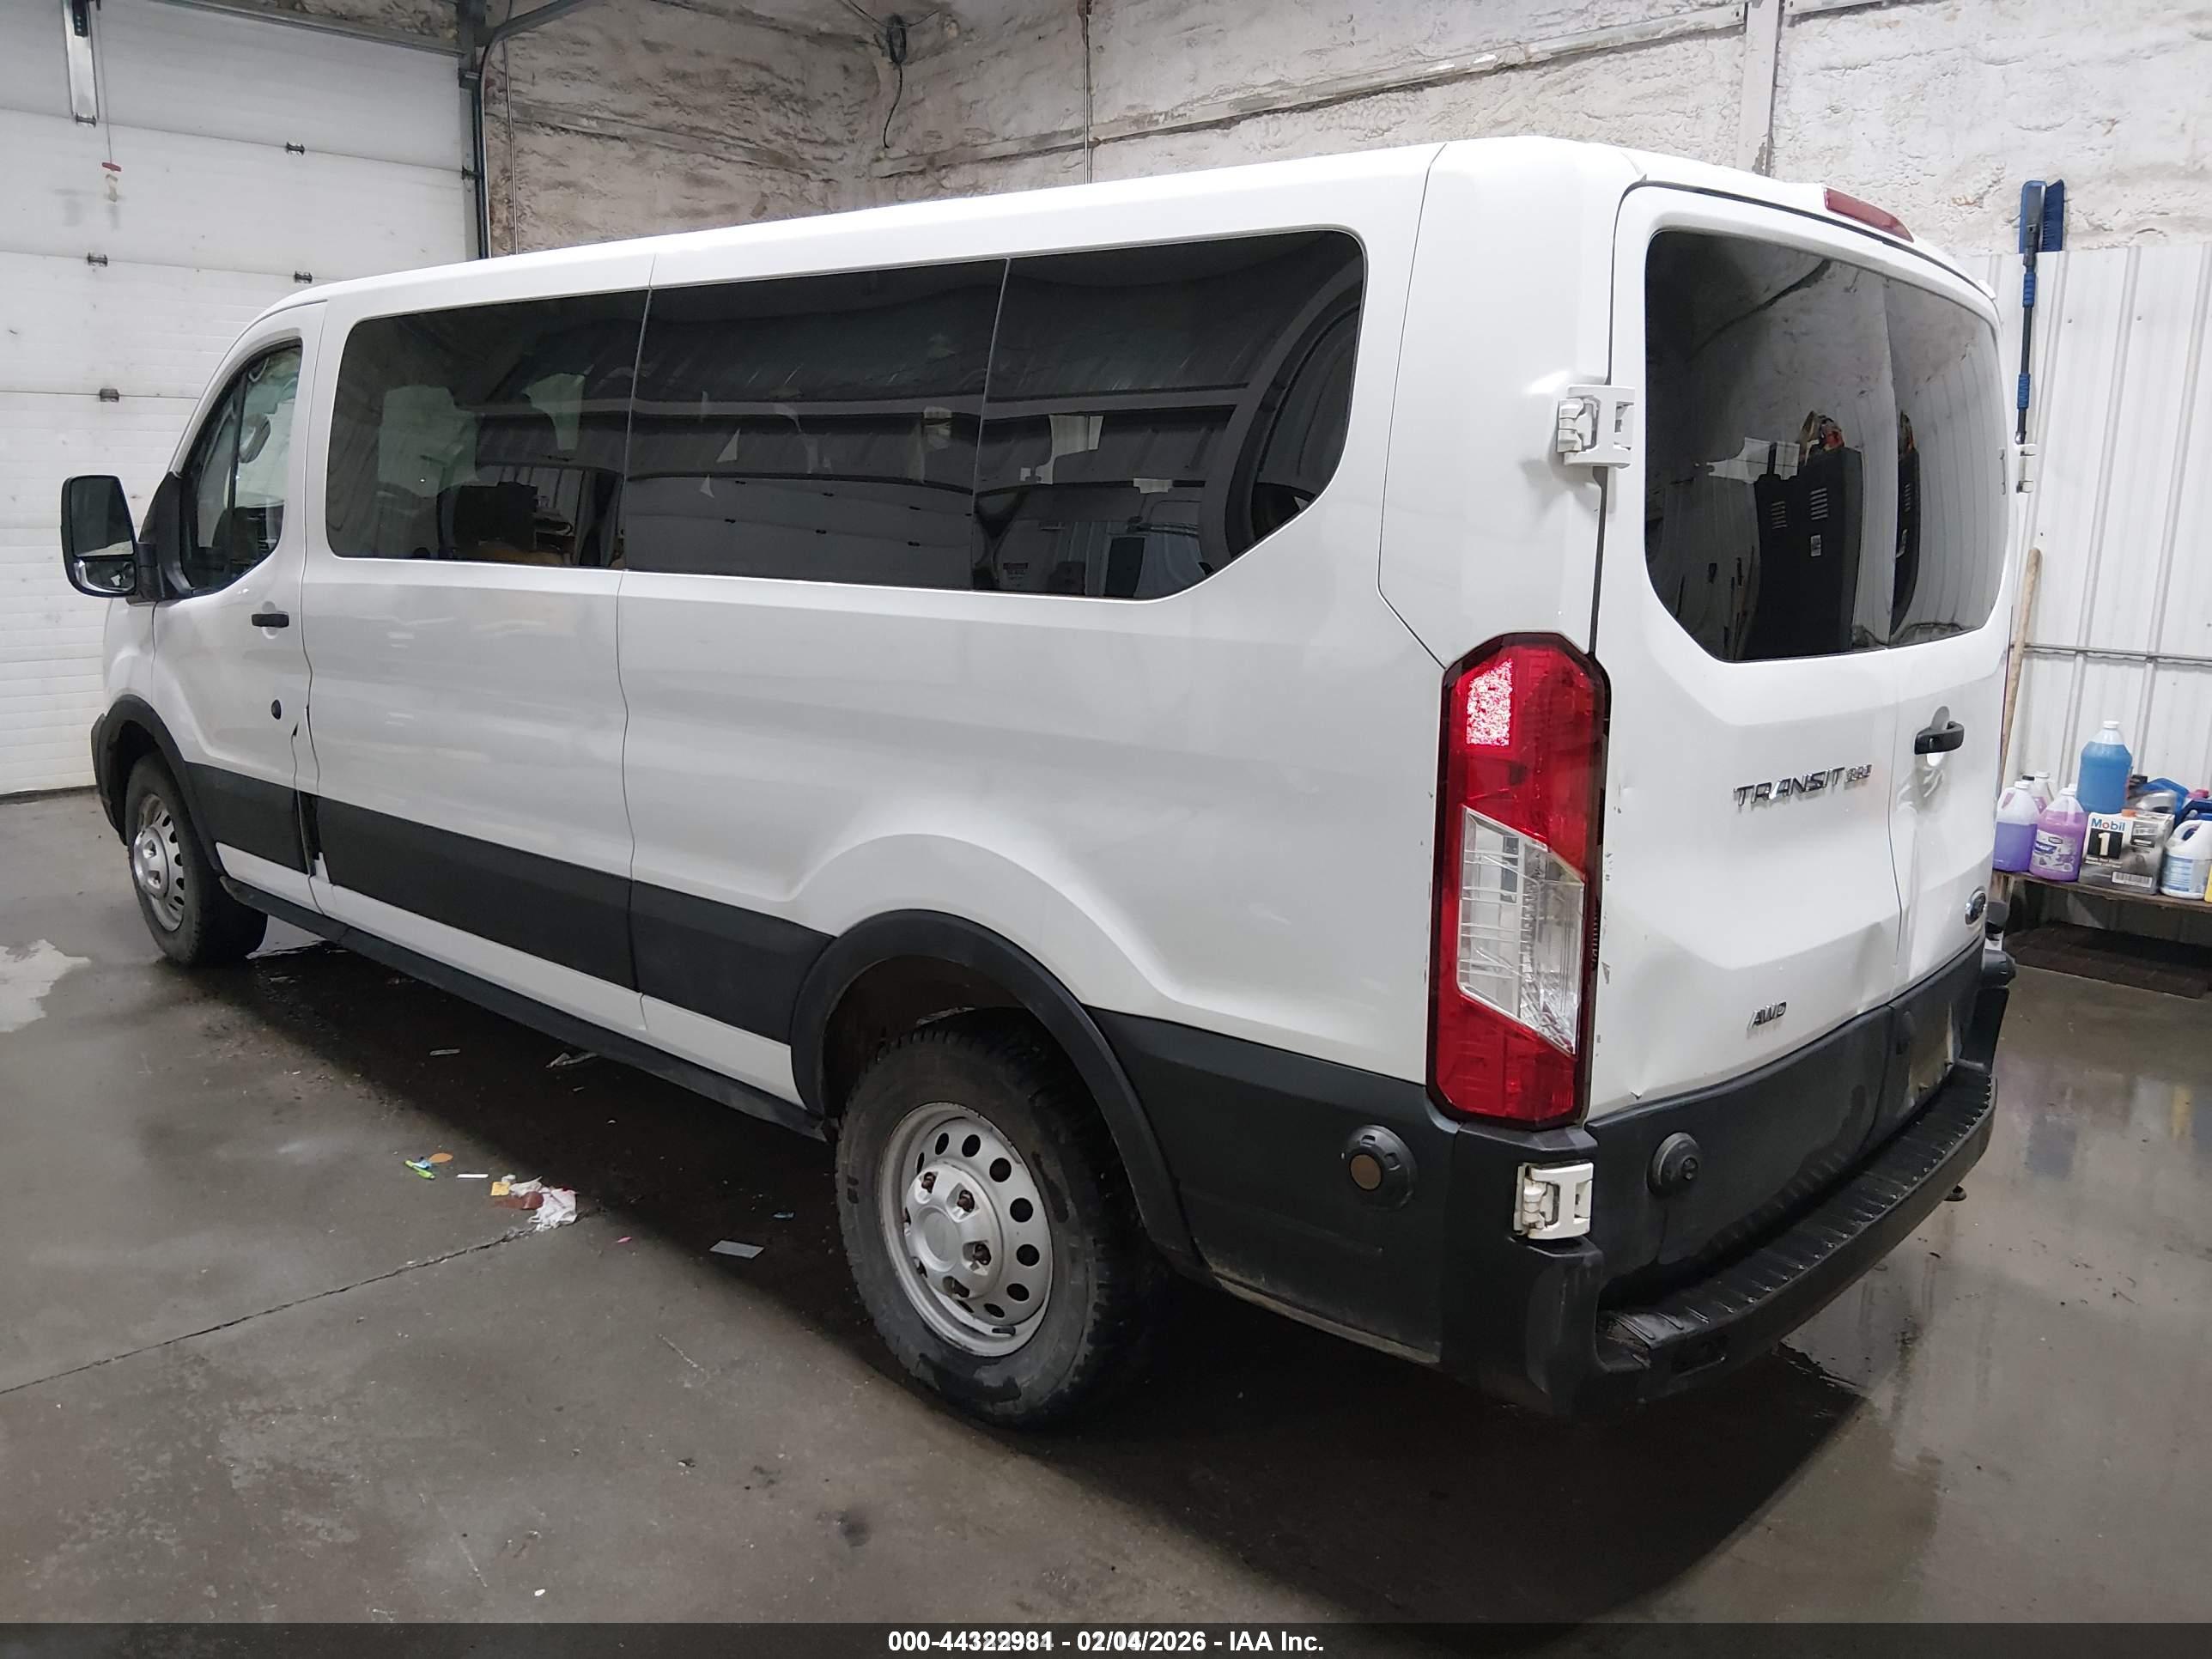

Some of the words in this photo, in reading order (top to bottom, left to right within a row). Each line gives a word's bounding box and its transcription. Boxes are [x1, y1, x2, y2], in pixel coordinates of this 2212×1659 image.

[1733, 767, 1845, 806] TRANSIT
[2091, 817, 2125, 831] Mobil
[2098, 832, 2111, 856] 1
[1747, 1001, 1787, 1030] AWD
